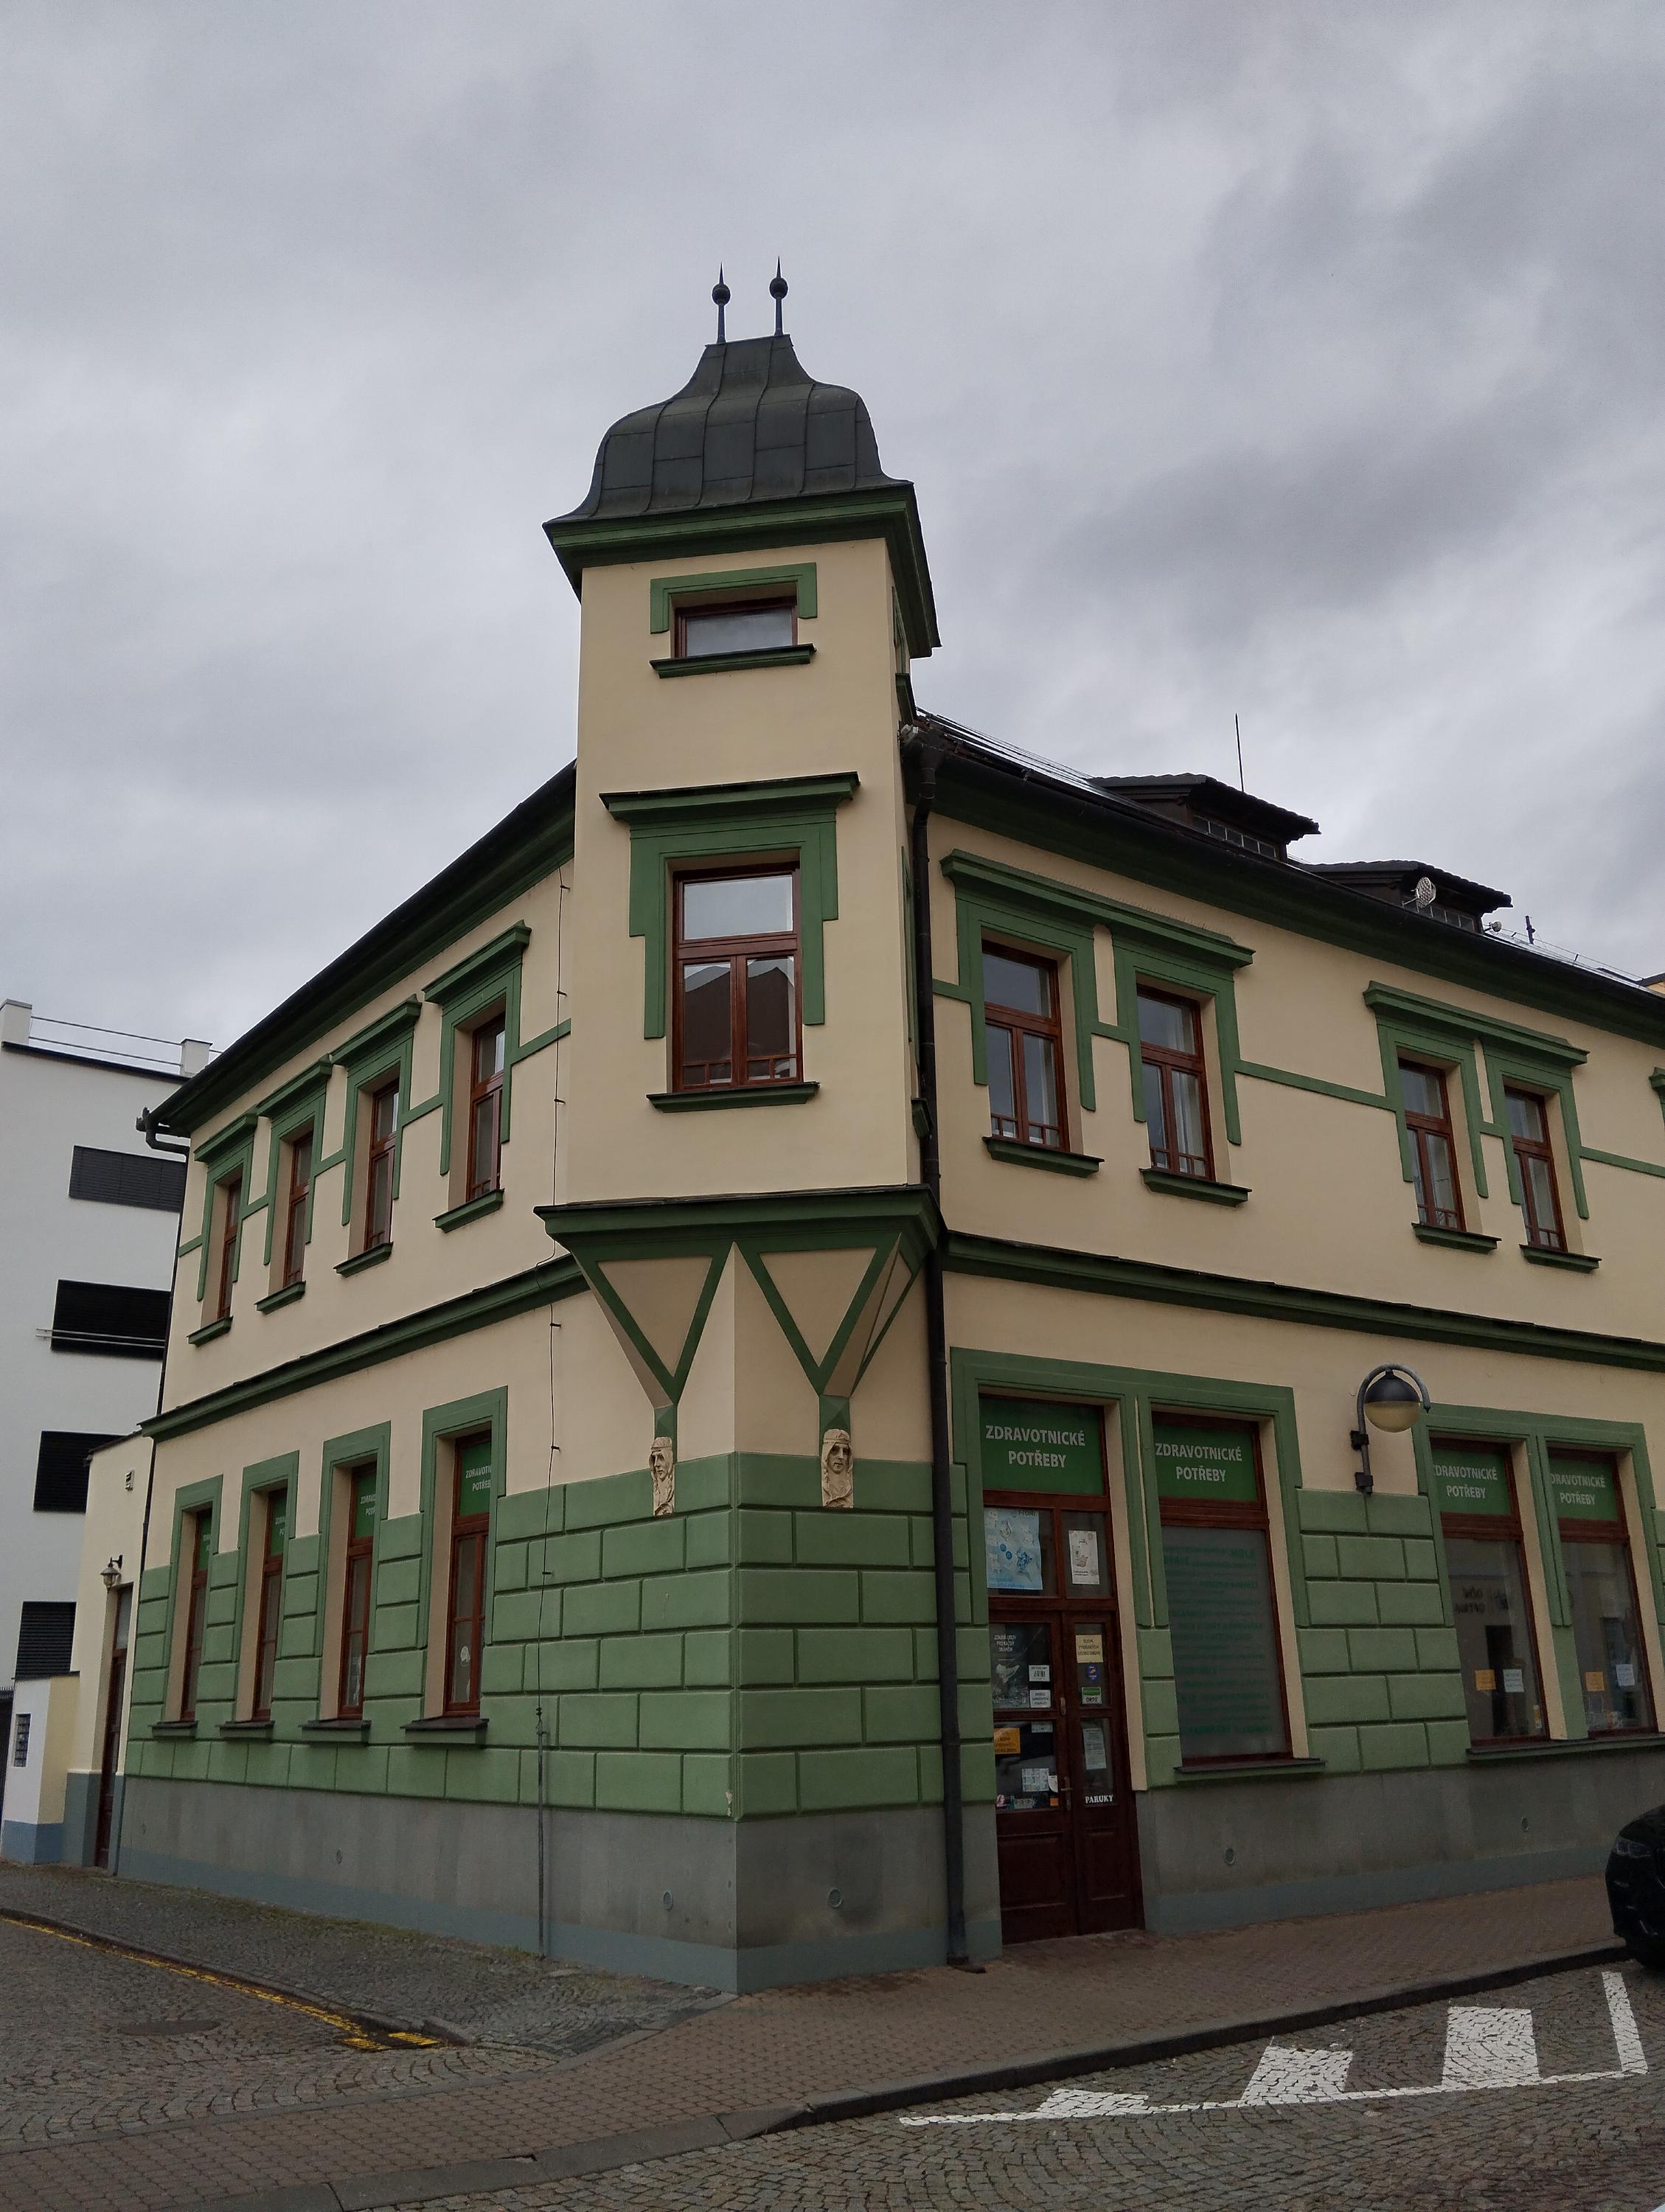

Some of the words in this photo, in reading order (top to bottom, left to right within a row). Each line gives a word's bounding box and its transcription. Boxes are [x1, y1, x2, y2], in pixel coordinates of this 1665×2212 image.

[986, 1425, 1086, 1446] ZDRAVOTNICKÉ
[1008, 1450, 1067, 1468] POTŘEBY
[1155, 1443, 1242, 1462] ZDRAVOTNICKÉ
[1175, 1465, 1226, 1482] POTŘEBY
[1550, 1473, 1606, 1488] DRAVOTNICKÉ
[1446, 1484, 1487, 1499] POTŘEBY
[1559, 1491, 1596, 1505] POTŘEBY
[1085, 1794, 1113, 1804] PARUKY
